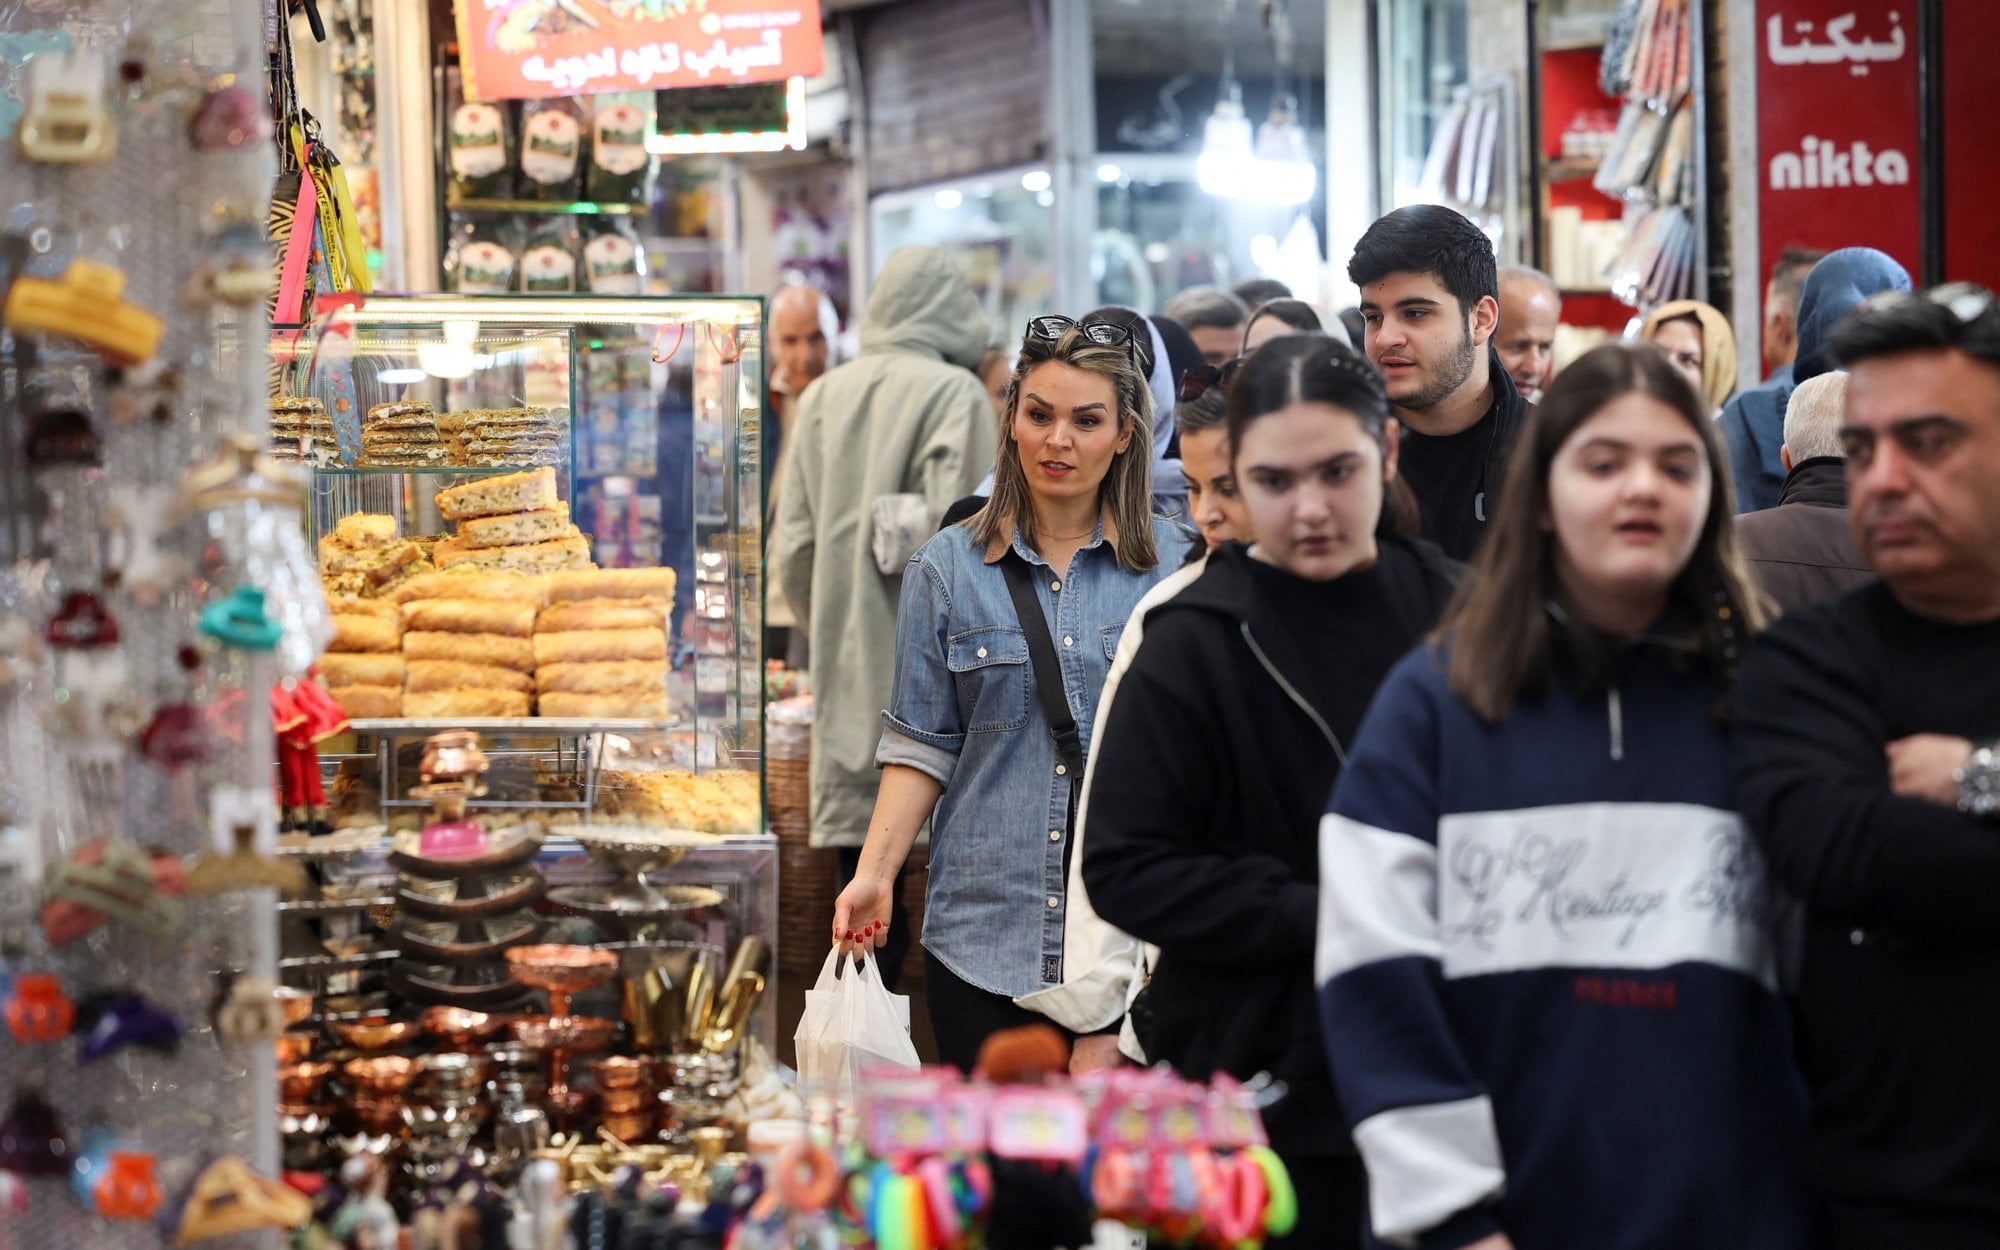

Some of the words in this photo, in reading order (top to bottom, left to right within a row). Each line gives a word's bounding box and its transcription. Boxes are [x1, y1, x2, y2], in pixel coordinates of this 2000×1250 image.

[522, 47, 617, 89] ادویه
[620, 43, 681, 83] تازه
[683, 29, 782, 78] آسیاب
[1766, 10, 1906, 77] نیکتا
[1769, 135, 1909, 190] nikta
